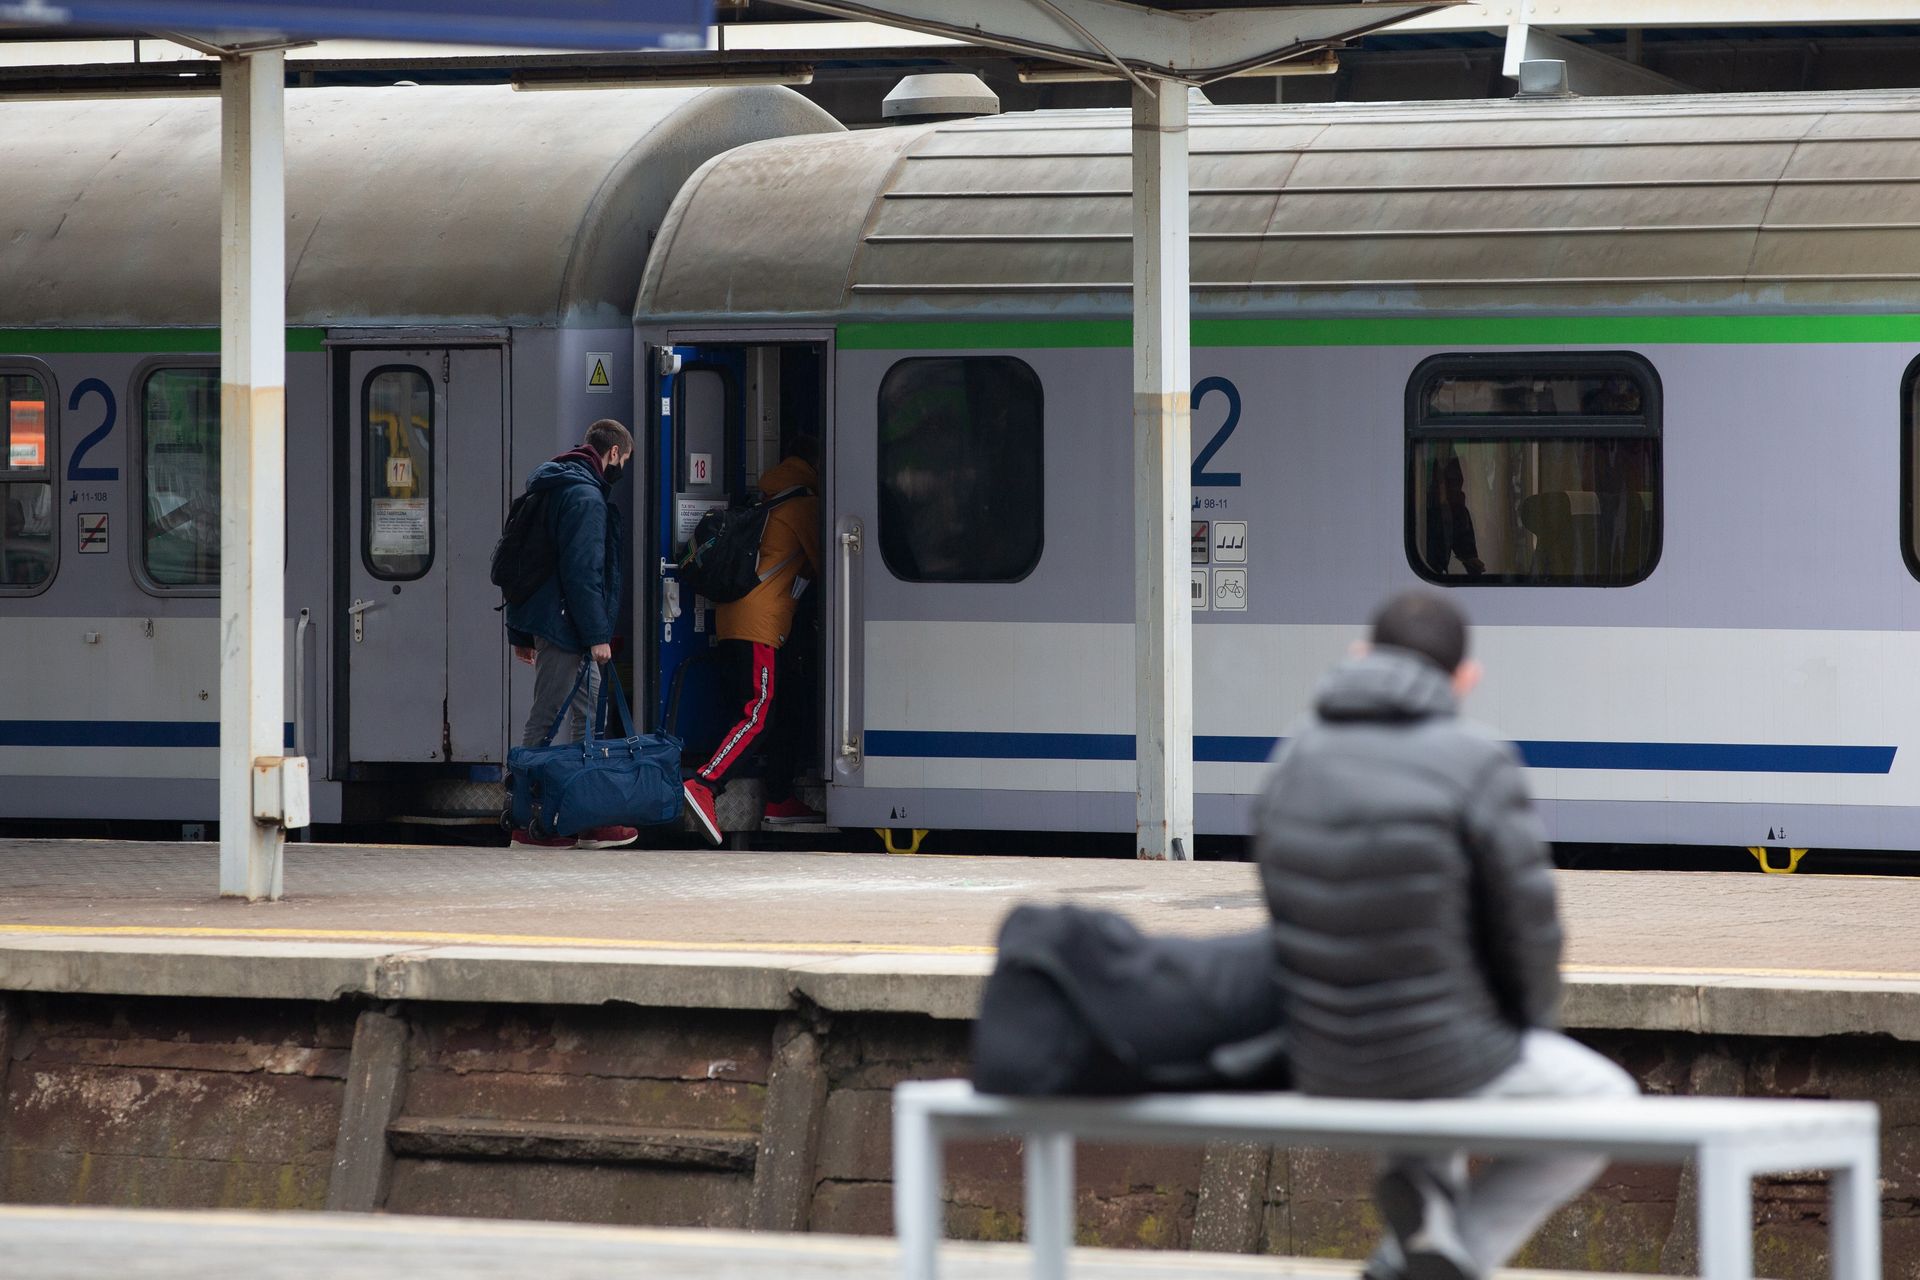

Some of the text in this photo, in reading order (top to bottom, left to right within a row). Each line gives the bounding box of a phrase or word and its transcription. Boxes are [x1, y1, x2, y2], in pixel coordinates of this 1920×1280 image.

[67, 378, 119, 480] 2
[1190, 376, 1241, 487] 2
[393, 463, 405, 481] 17
[695, 460, 706, 479] 18
[81, 492, 107, 501] 11-108
[1204, 499, 1228, 509] 98-11
